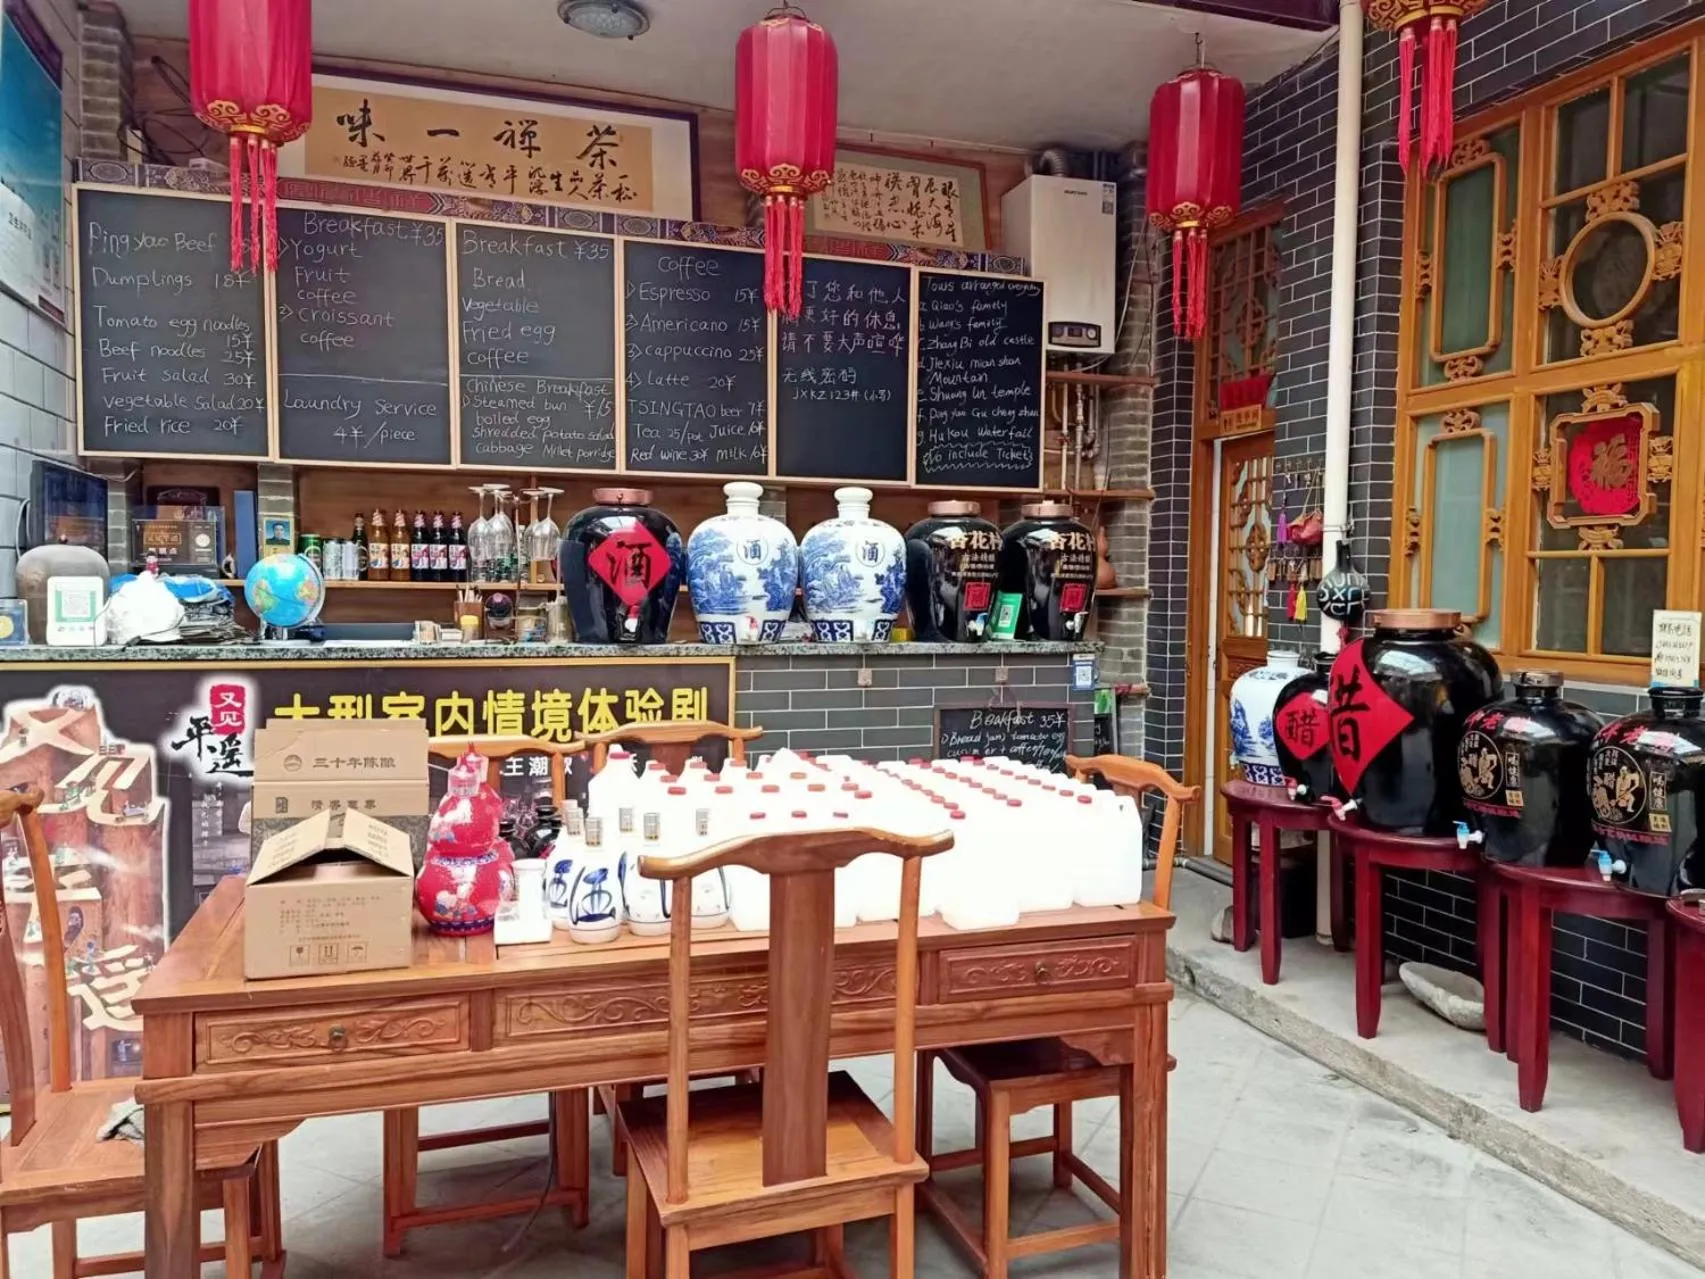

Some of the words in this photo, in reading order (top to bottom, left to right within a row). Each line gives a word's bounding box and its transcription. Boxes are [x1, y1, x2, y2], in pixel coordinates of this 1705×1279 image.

[175, 232, 216, 252] Beef
[290, 239, 363, 264] Yogurt
[463, 230, 568, 259] Breakfast
[295, 266, 350, 286] Fruit
[657, 255, 722, 280] Coffee
[92, 266, 192, 296] Dumplings
[472, 268, 525, 289] Bread
[639, 282, 712, 309] Espresso
[797, 280, 906, 304] 了您和他人
[93, 305, 158, 329] Tomato
[169, 320, 198, 337] egg
[203, 314, 249, 332] noodles
[640, 313, 729, 334] Americano
[463, 321, 512, 344] Fried
[520, 325, 556, 345] egg
[99, 338, 141, 361] Beef
[151, 343, 205, 358] noodles
[102, 367, 147, 383] Fruit
[162, 368, 210, 383] salad
[466, 377, 526, 393] Chinese
[647, 373, 690, 388] Latte
[283, 389, 362, 420] Laundry
[628, 399, 717, 419] TSINGTAO
[104, 415, 149, 437] Fried
[160, 418, 191, 434] rice
[527, 415, 551, 430] egg
[633, 423, 661, 439] Tea
[709, 424, 744, 439] Juice
[630, 444, 656, 464] Red
[660, 447, 688, 462] wine
[743, 540, 762, 560] 酒
[862, 541, 879, 562] 酒
[606, 541, 652, 585] 酒
[1285, 708, 1320, 748] 醋
[313, 757, 396, 769] 三十年陈酿
